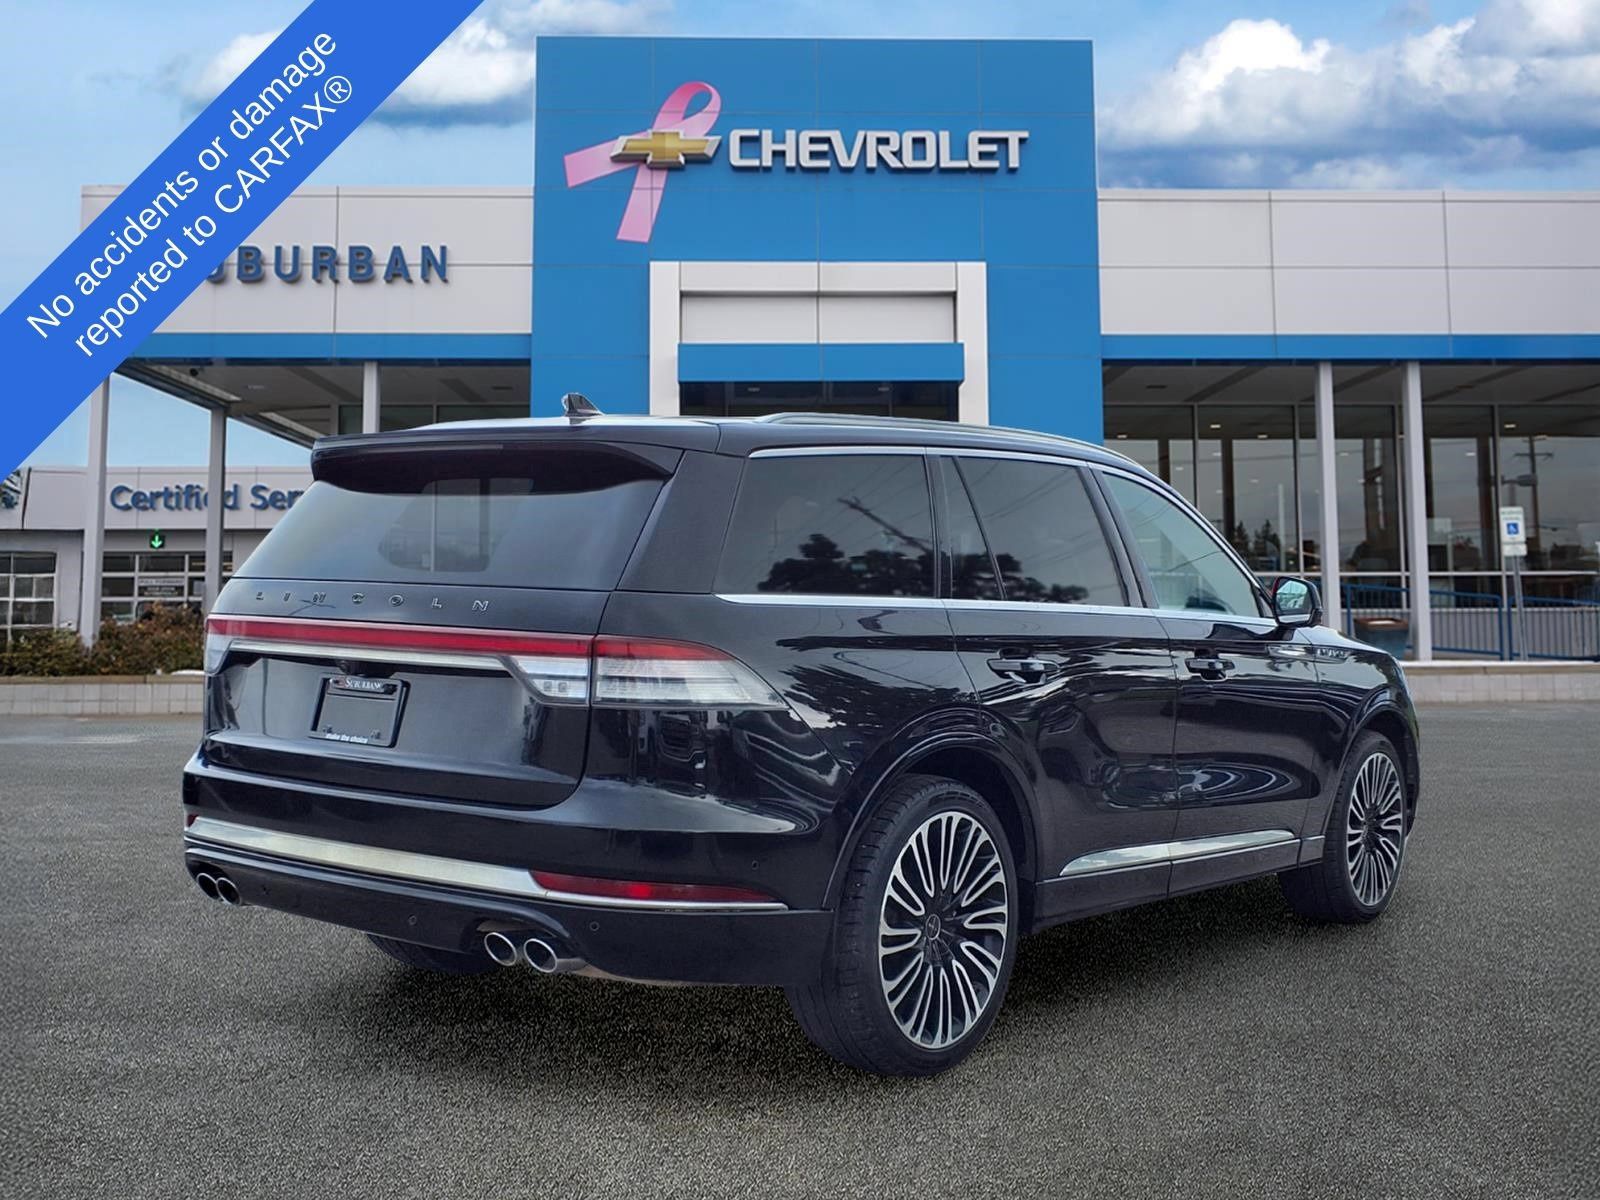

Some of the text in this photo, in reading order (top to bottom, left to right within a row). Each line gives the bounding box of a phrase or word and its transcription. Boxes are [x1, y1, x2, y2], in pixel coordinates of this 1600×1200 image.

[729, 129, 1029, 169] CHEVROLET
[110, 484, 239, 511] Certifid
[256, 591, 489, 612] LINCOLN
